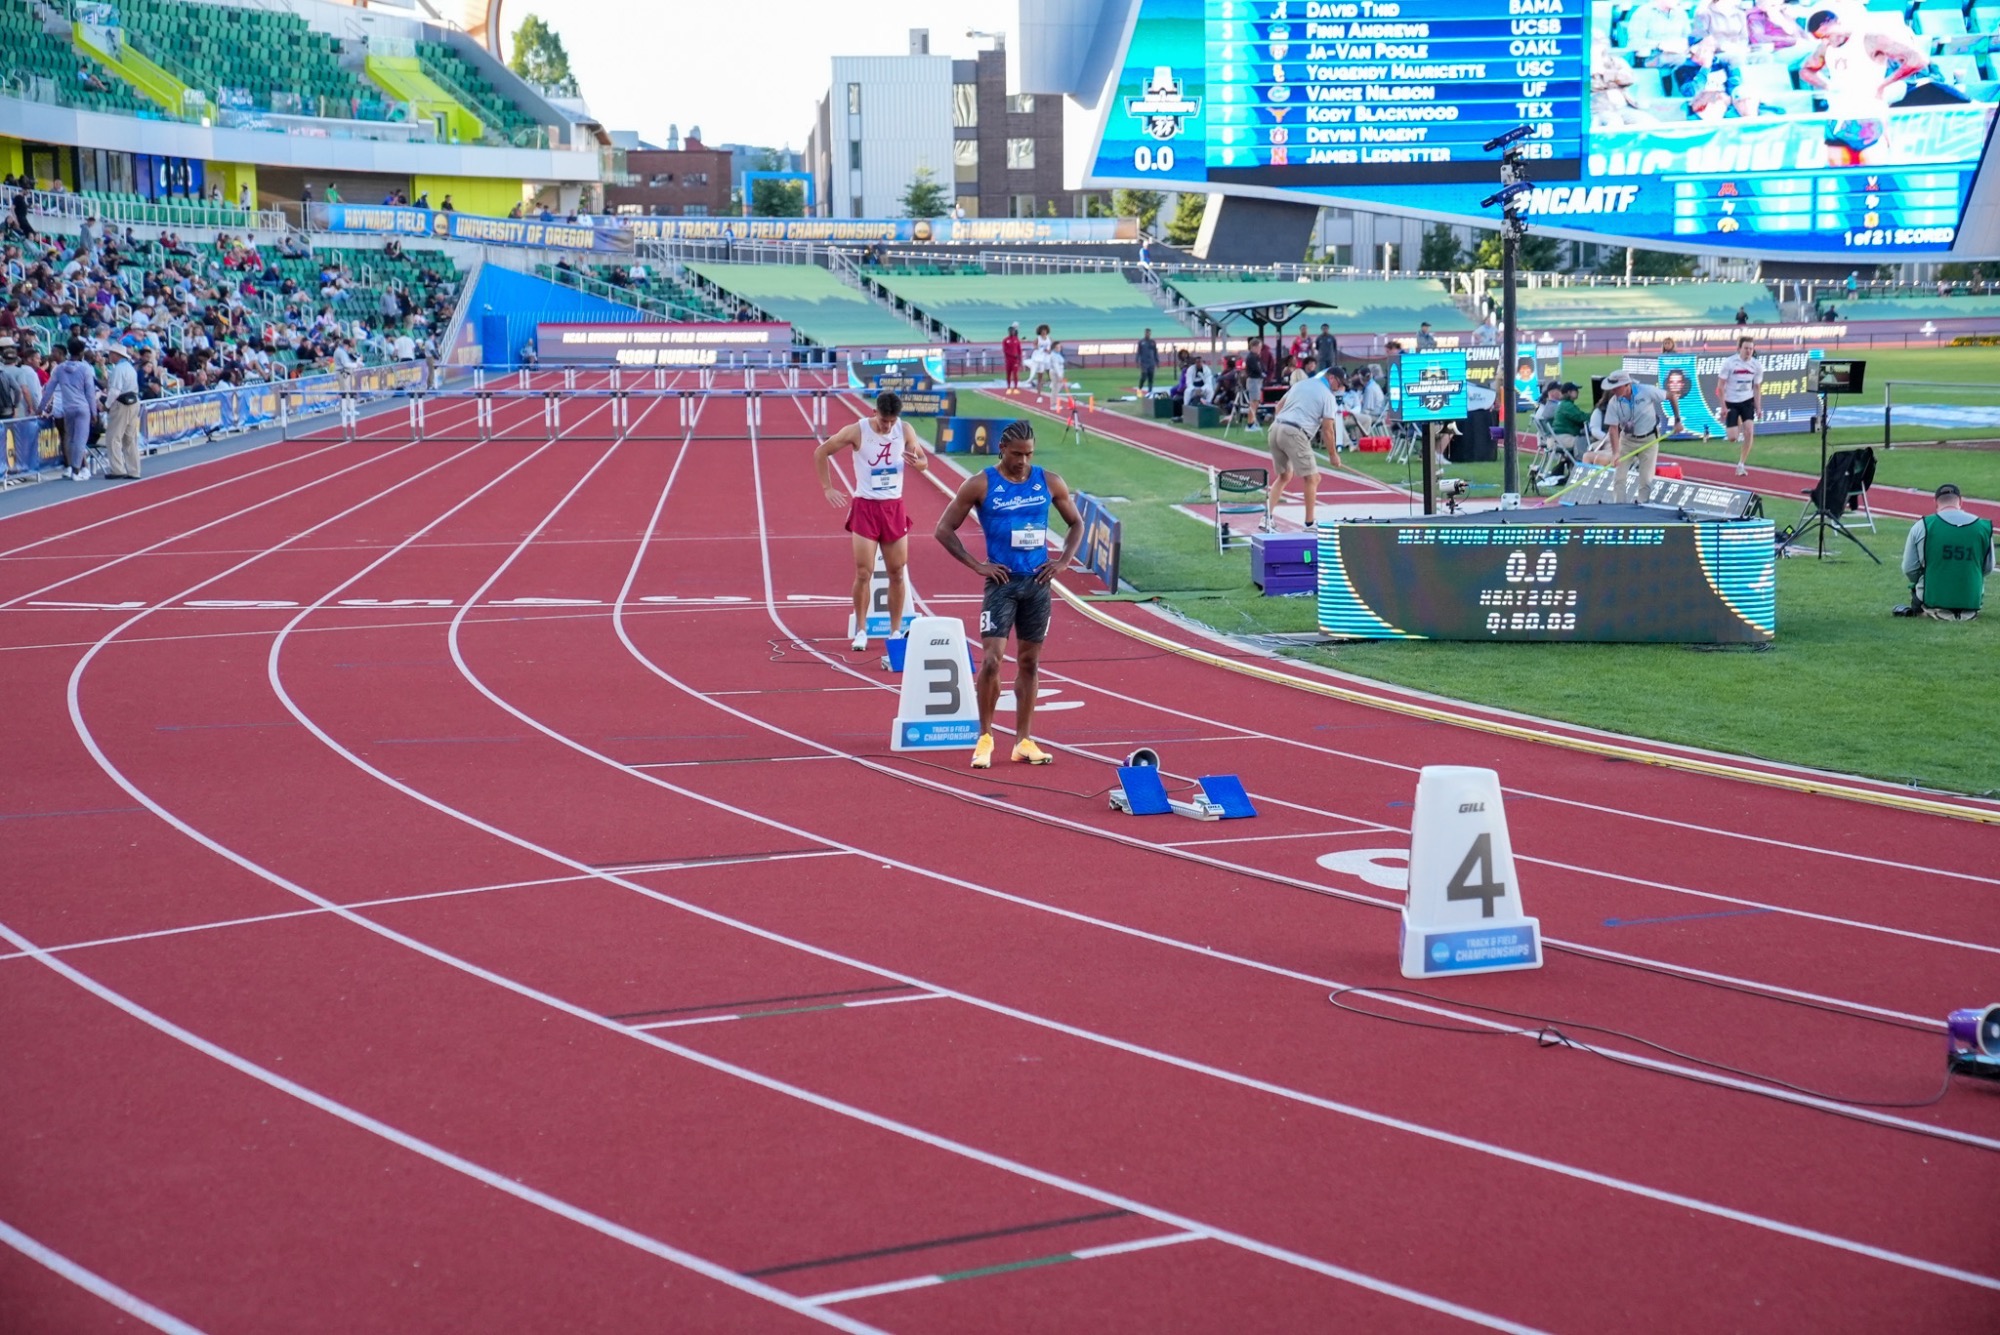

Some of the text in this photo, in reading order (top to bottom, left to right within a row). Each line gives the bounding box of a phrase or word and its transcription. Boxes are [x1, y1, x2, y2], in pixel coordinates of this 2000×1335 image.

[1509, 0, 1564, 14] BAMA
[1347, 22, 1430, 38] ANDREWS
[1511, 18, 1562, 35] UCSB
[1305, 42, 1429, 60] JA-VAN POOLE
[1509, 39, 1562, 56] OAKL
[1516, 60, 1555, 77] USC
[1305, 84, 1363, 101] VANCE
[1522, 81, 1549, 97] UF
[1306, 105, 1459, 122] KODY BLACKWOOD
[1515, 102, 1554, 119] TEX
[1306, 126, 1357, 143] DEVIN
[1134, 145, 1175, 172] 0.0
[1305, 147, 1358, 164] JAMES
[1513, 185, 1639, 215] #NCAATF
[344, 208, 426, 232] HAYWARD FIELD
[456, 217, 594, 249] UNIVERSITY OF OREGON
[678, 221, 718, 238] TRACK
[749, 221, 785, 239] FIELD
[786, 222, 896, 240] CHAMPIONSHIPS
[952, 221, 1035, 240] CHAMPIONS
[1844, 231, 1852, 246] 1
[1465, 367, 1496, 384] empt
[1760, 379, 1798, 399] empt
[867, 443, 893, 466] A
[1505, 549, 1558, 582] 0.0
[1479, 589, 1526, 606] HEAT
[1527, 589, 1539, 606] 2
[1565, 589, 1577, 606] 3
[981, 613, 988, 631] 3
[930, 638, 950, 646] GILL
[924, 659, 960, 716] 3
[924, 732, 979, 742] CHAMPIONSHIPS
[1458, 802, 1485, 813] GILL
[1446, 832, 1505, 919] 4
[1466, 937, 1490, 949] TRACK
[1455, 944, 1530, 962] CHAMPIONSHIPS
